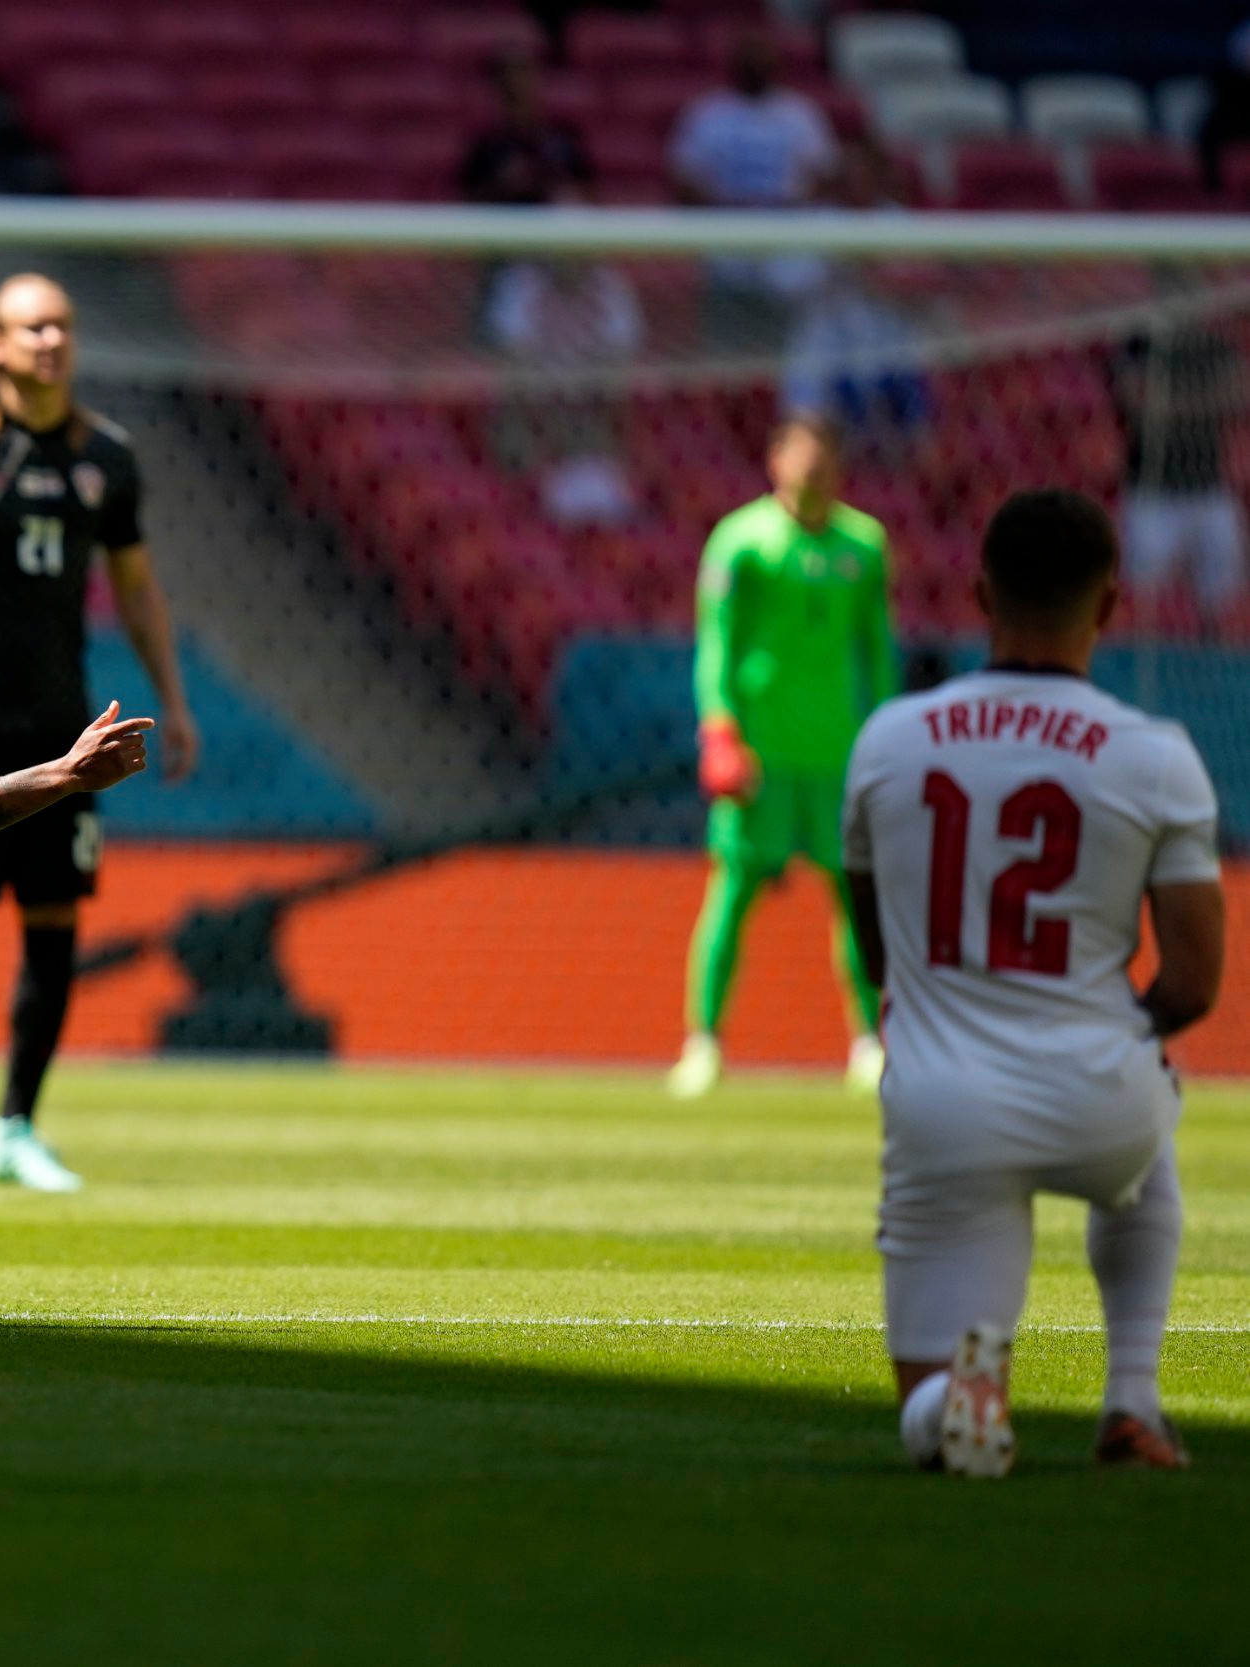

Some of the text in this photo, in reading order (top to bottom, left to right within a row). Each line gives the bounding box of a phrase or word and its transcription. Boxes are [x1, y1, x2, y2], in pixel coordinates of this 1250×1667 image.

[17, 517, 63, 576] 21
[923, 700, 1111, 762] TRIPPIER
[922, 769, 1082, 976] 12
